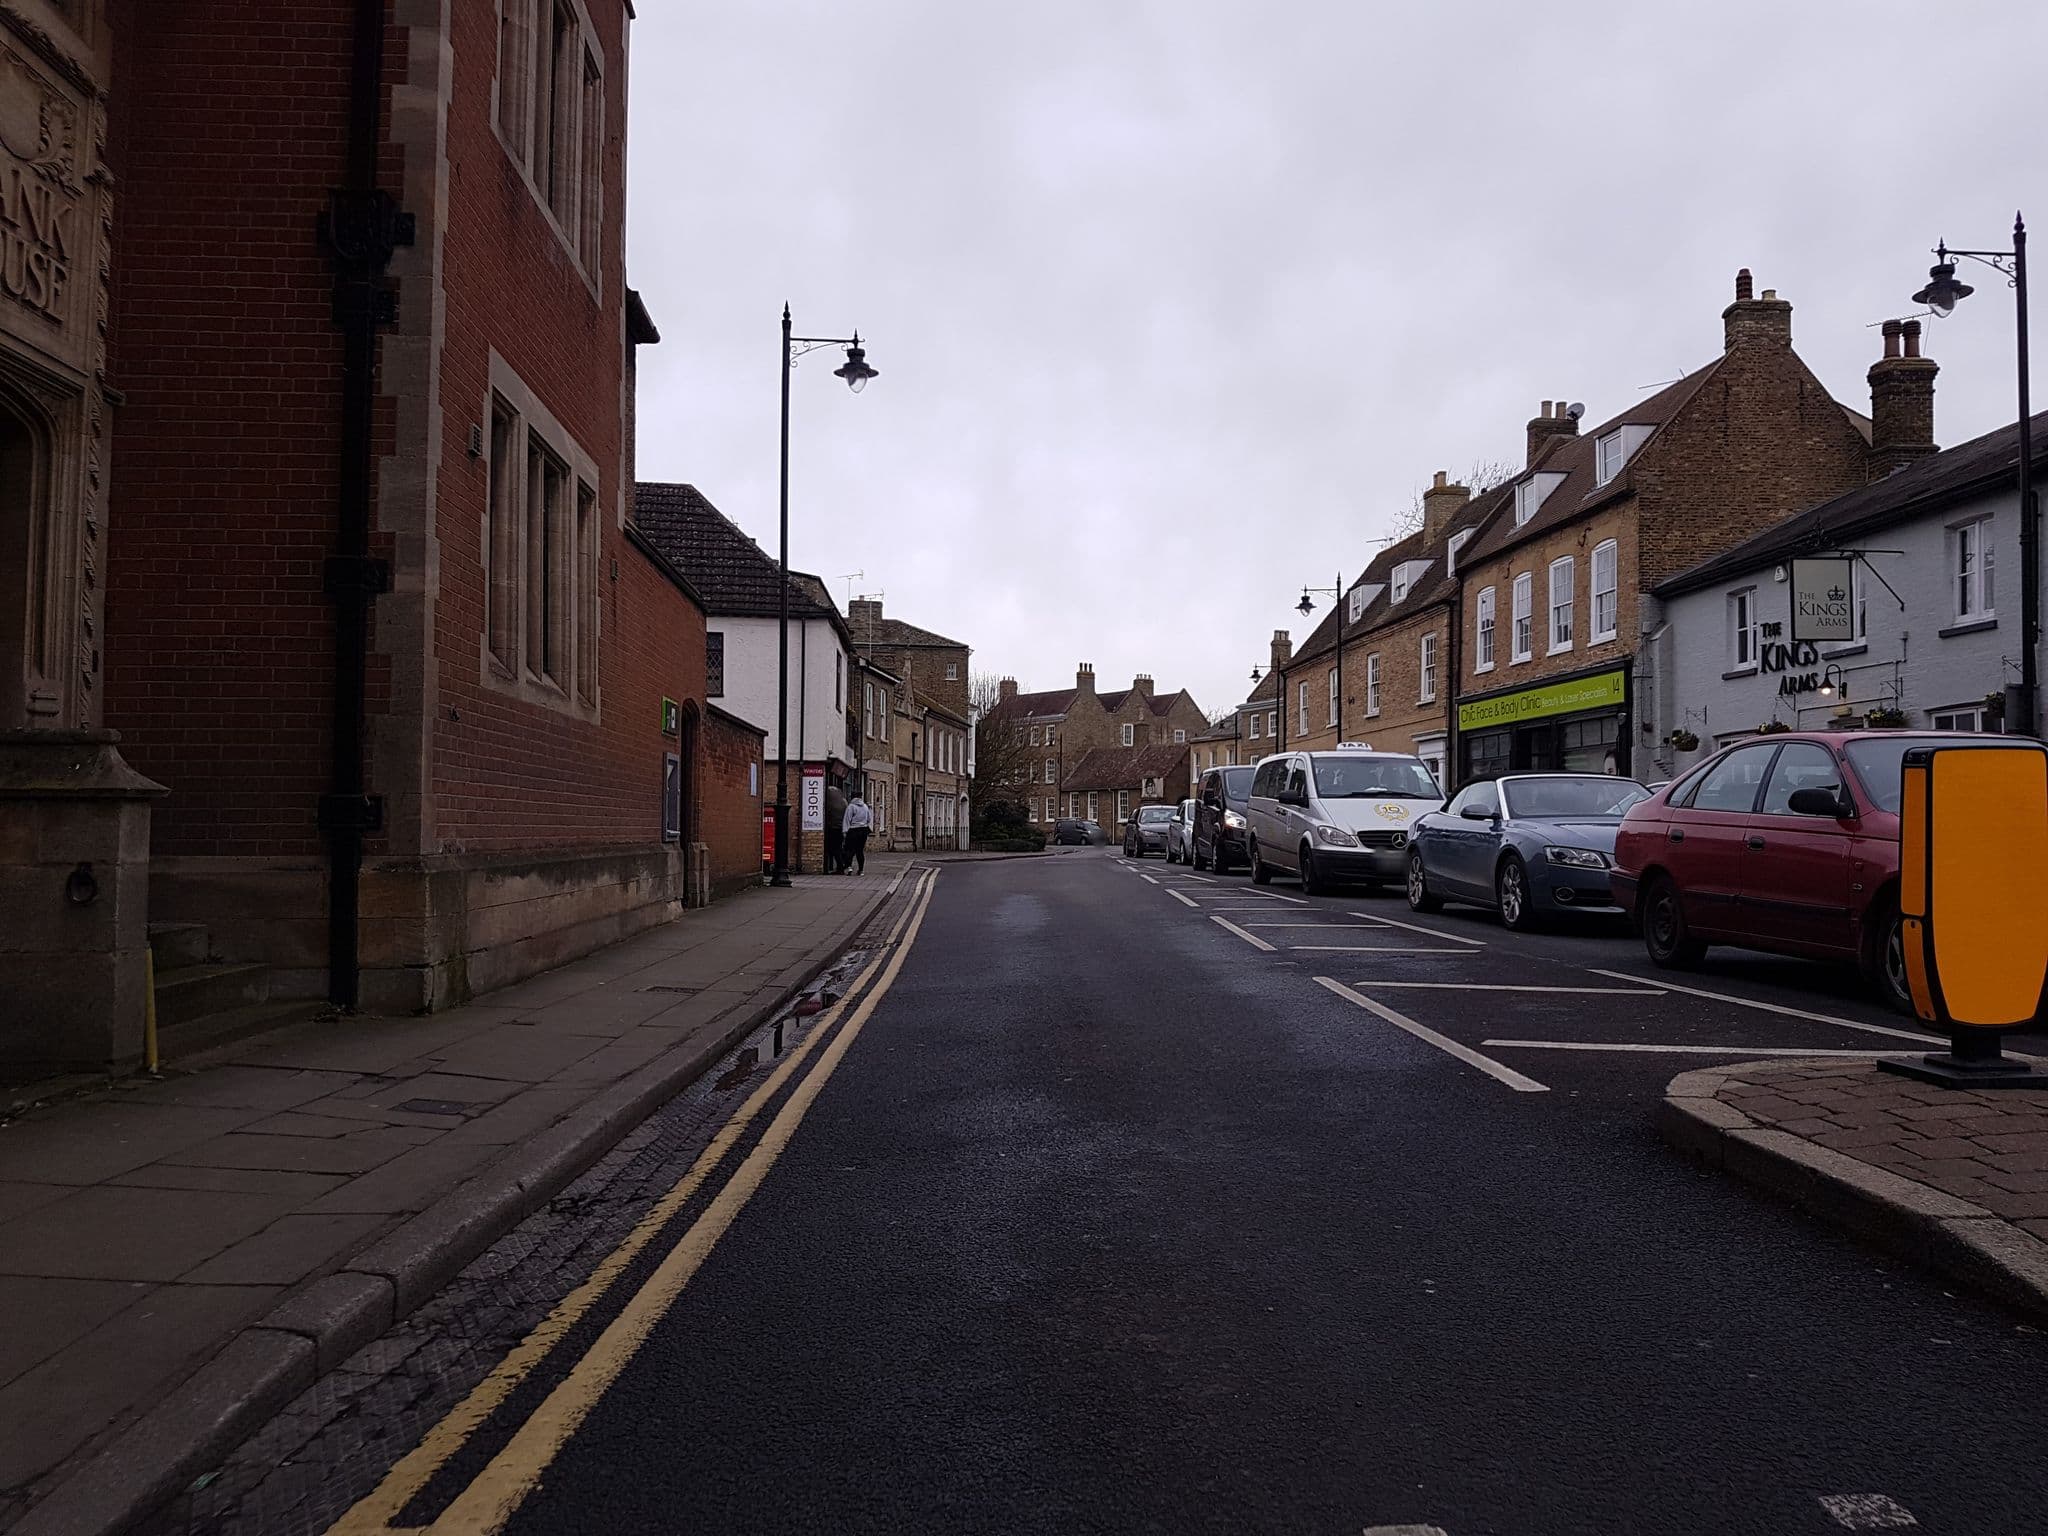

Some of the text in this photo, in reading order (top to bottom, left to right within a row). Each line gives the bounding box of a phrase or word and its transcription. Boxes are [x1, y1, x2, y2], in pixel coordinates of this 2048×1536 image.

[1798, 591, 1816, 600] THE
[1799, 601, 1848, 616] KINGS
[1760, 621, 1782, 638] THE
[1816, 617, 1848, 627] ARMS
[1760, 640, 1819, 674] KINGS
[1778, 672, 1819, 696] ARMS
[1476, 705, 1493, 720] Face
[1501, 698, 1519, 718] Body
[1520, 694, 1541, 712] Clinic
[808, 780, 819, 817] SHOES
